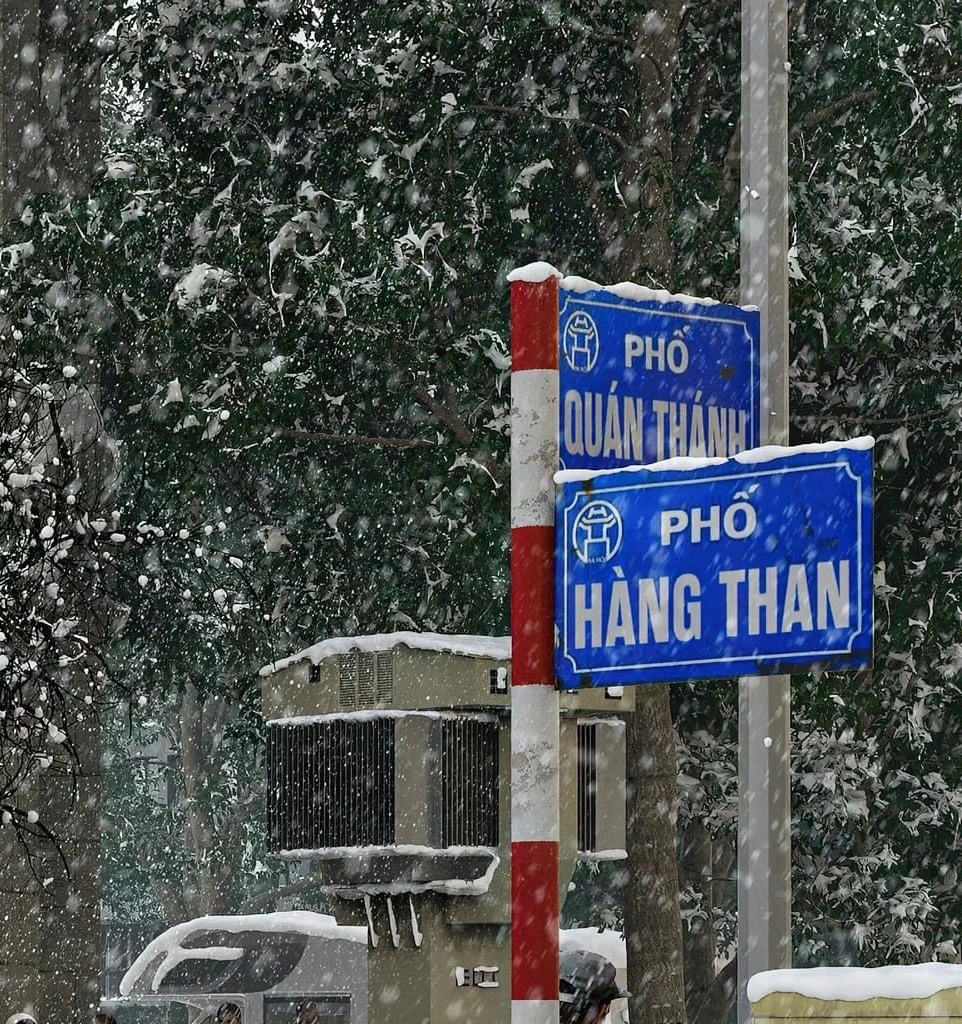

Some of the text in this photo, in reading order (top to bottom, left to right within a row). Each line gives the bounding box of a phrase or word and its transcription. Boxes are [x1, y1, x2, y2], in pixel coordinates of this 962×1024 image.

[624, 325, 690, 374] PHỐ
[564, 380, 746, 462] QUÁN THÁNH
[660, 483, 760, 546] PHỐ
[573, 559, 851, 650] HÀNG THAN
